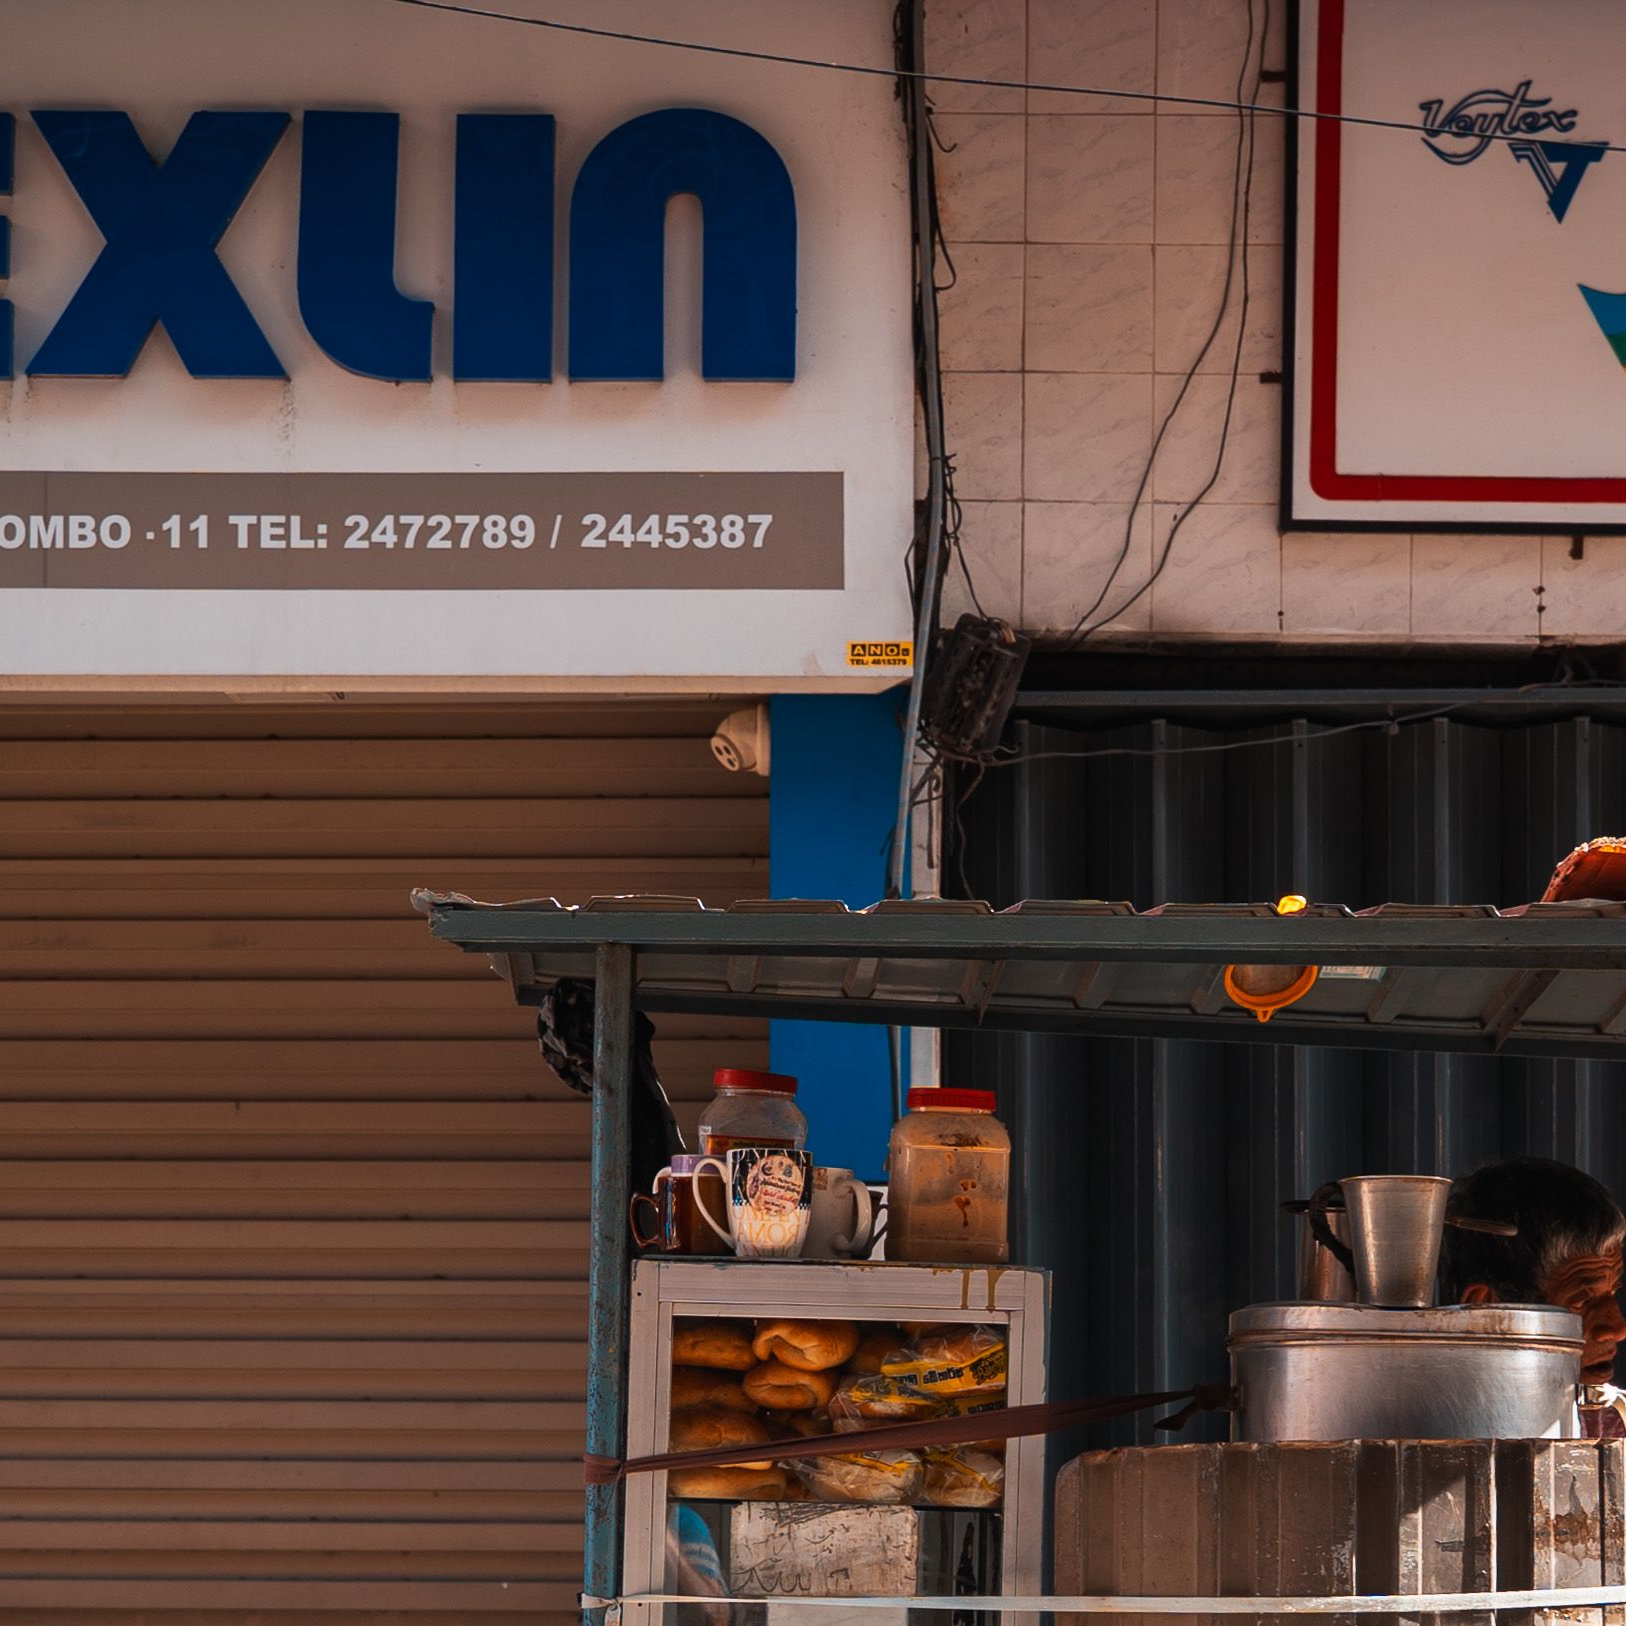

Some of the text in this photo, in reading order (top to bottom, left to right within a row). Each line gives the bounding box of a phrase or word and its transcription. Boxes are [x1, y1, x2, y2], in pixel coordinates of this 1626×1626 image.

[229, 514, 328, 550] TEL:
[344, 514, 536, 551] 2472789
[581, 514, 773, 550] 2445387
